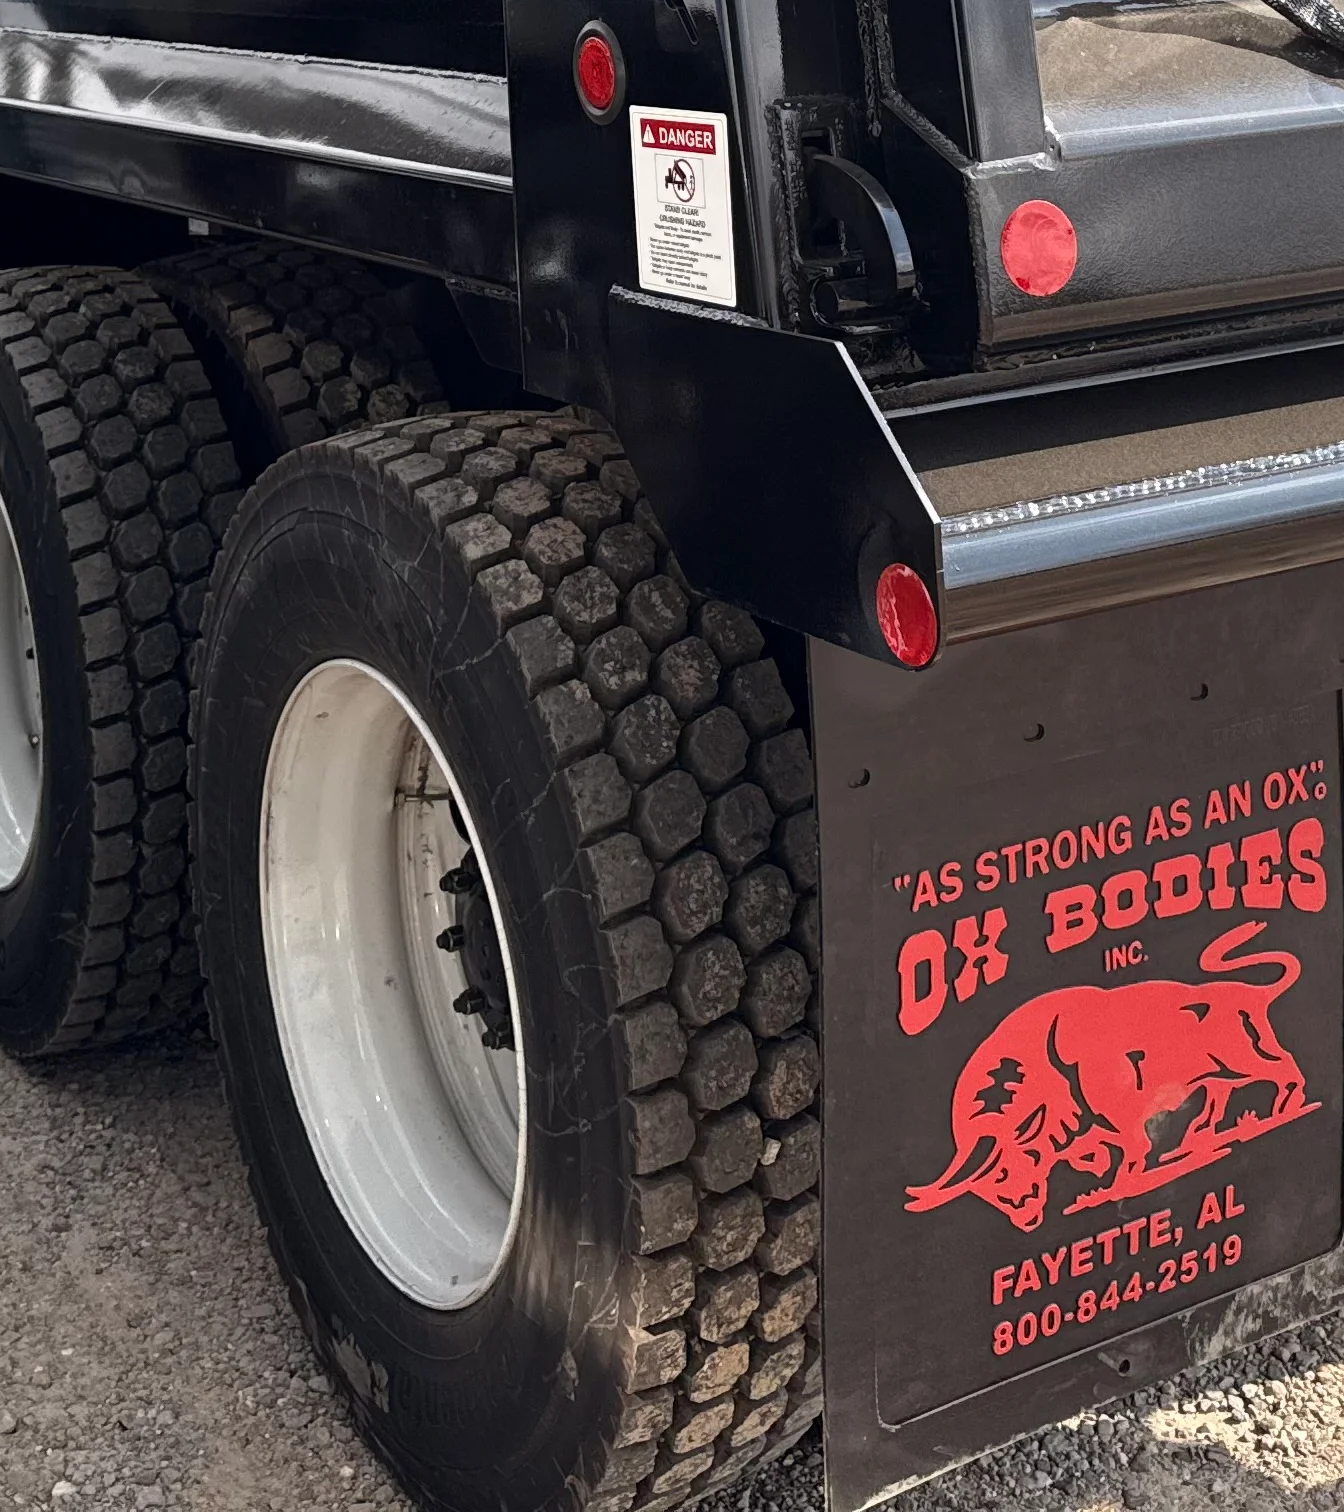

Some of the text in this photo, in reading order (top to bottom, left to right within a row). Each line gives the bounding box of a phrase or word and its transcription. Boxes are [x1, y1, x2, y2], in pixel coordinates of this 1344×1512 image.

[658, 126, 714, 150] DANGER
[974, 814, 1133, 892] STRONG
[1144, 797, 1193, 846] AS
[1203, 779, 1252, 829] AN
[896, 817, 1327, 1036] OX BODIES
[1104, 940, 1150, 973] INC.
[991, 1233, 1243, 1357] 800-844-2519
[992, 1183, 1246, 1306] FAYETTE, AL
